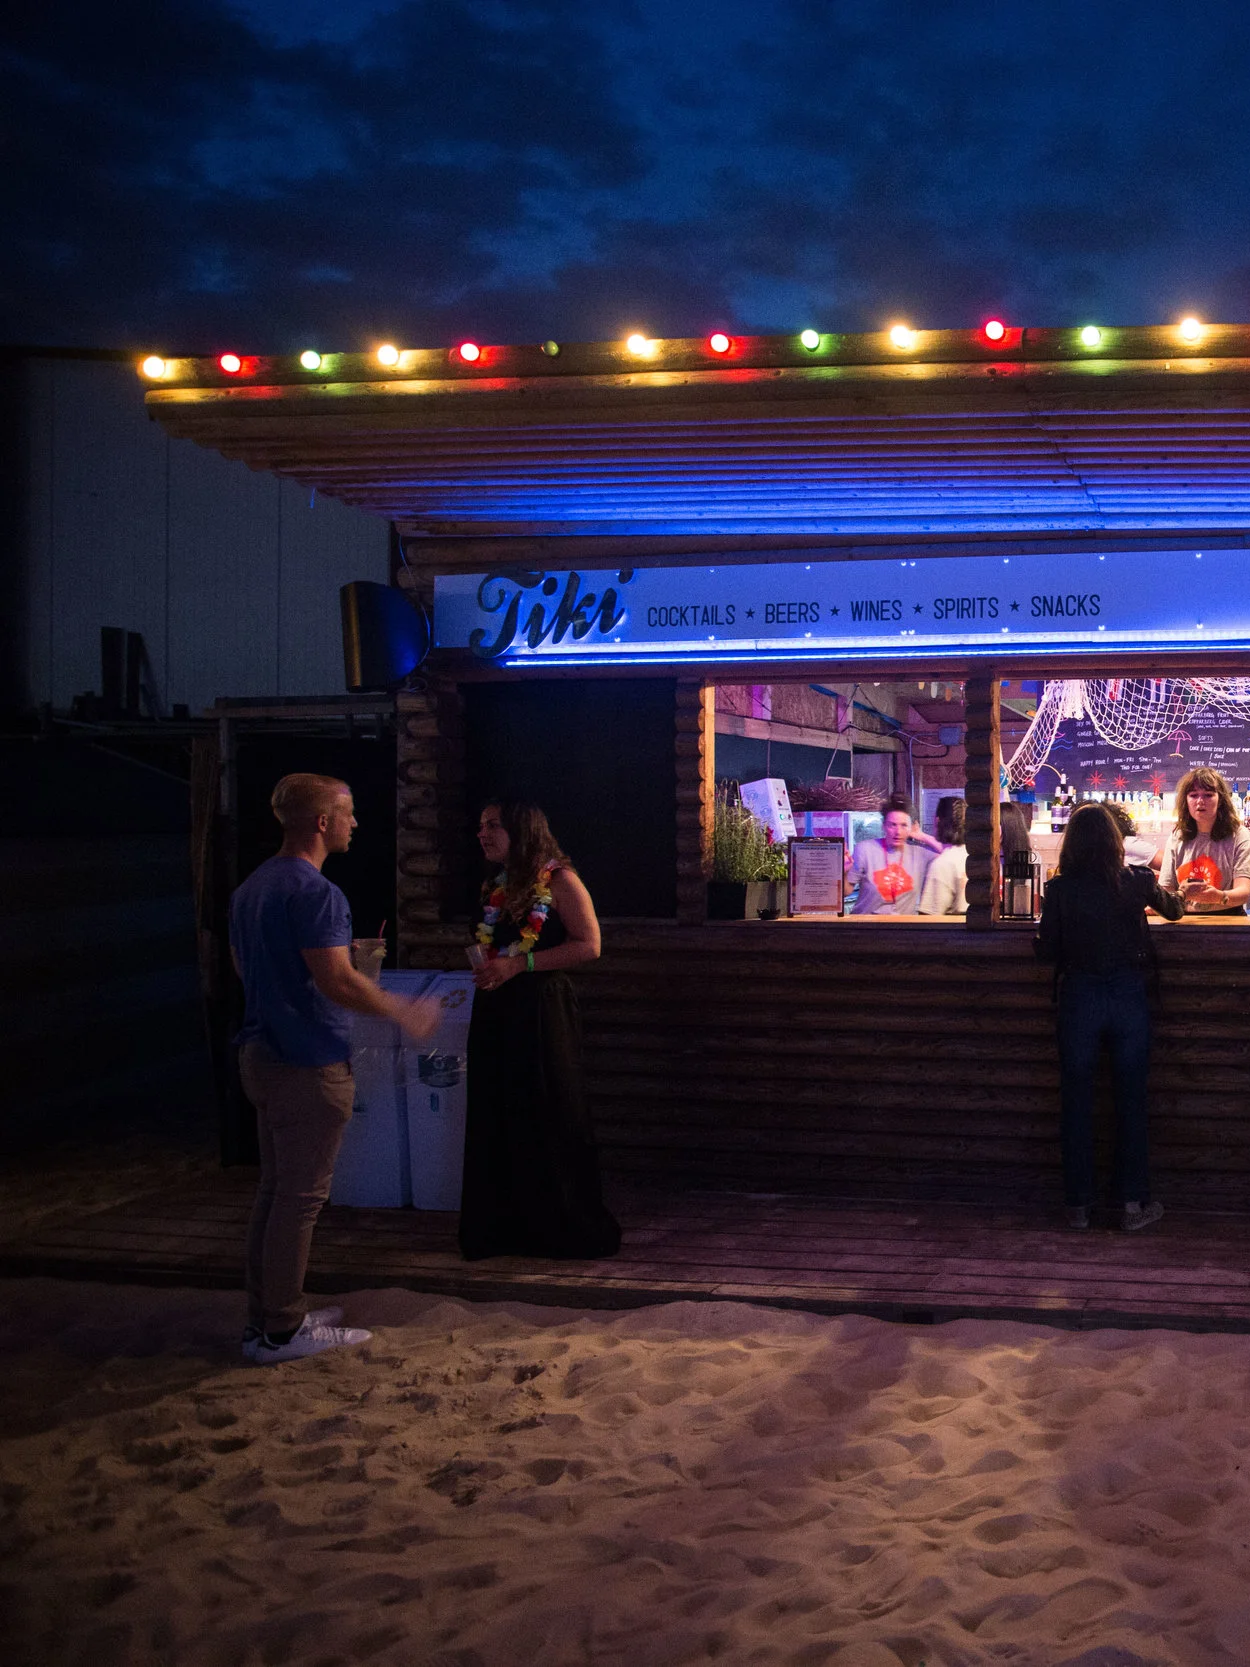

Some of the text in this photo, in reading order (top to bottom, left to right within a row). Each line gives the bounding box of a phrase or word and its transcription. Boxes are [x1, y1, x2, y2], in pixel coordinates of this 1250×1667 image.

[469, 567, 634, 658] Tiki
[647, 594, 1100, 627] COCKTAILS BEERS WINES SPIRITS SNACKS
